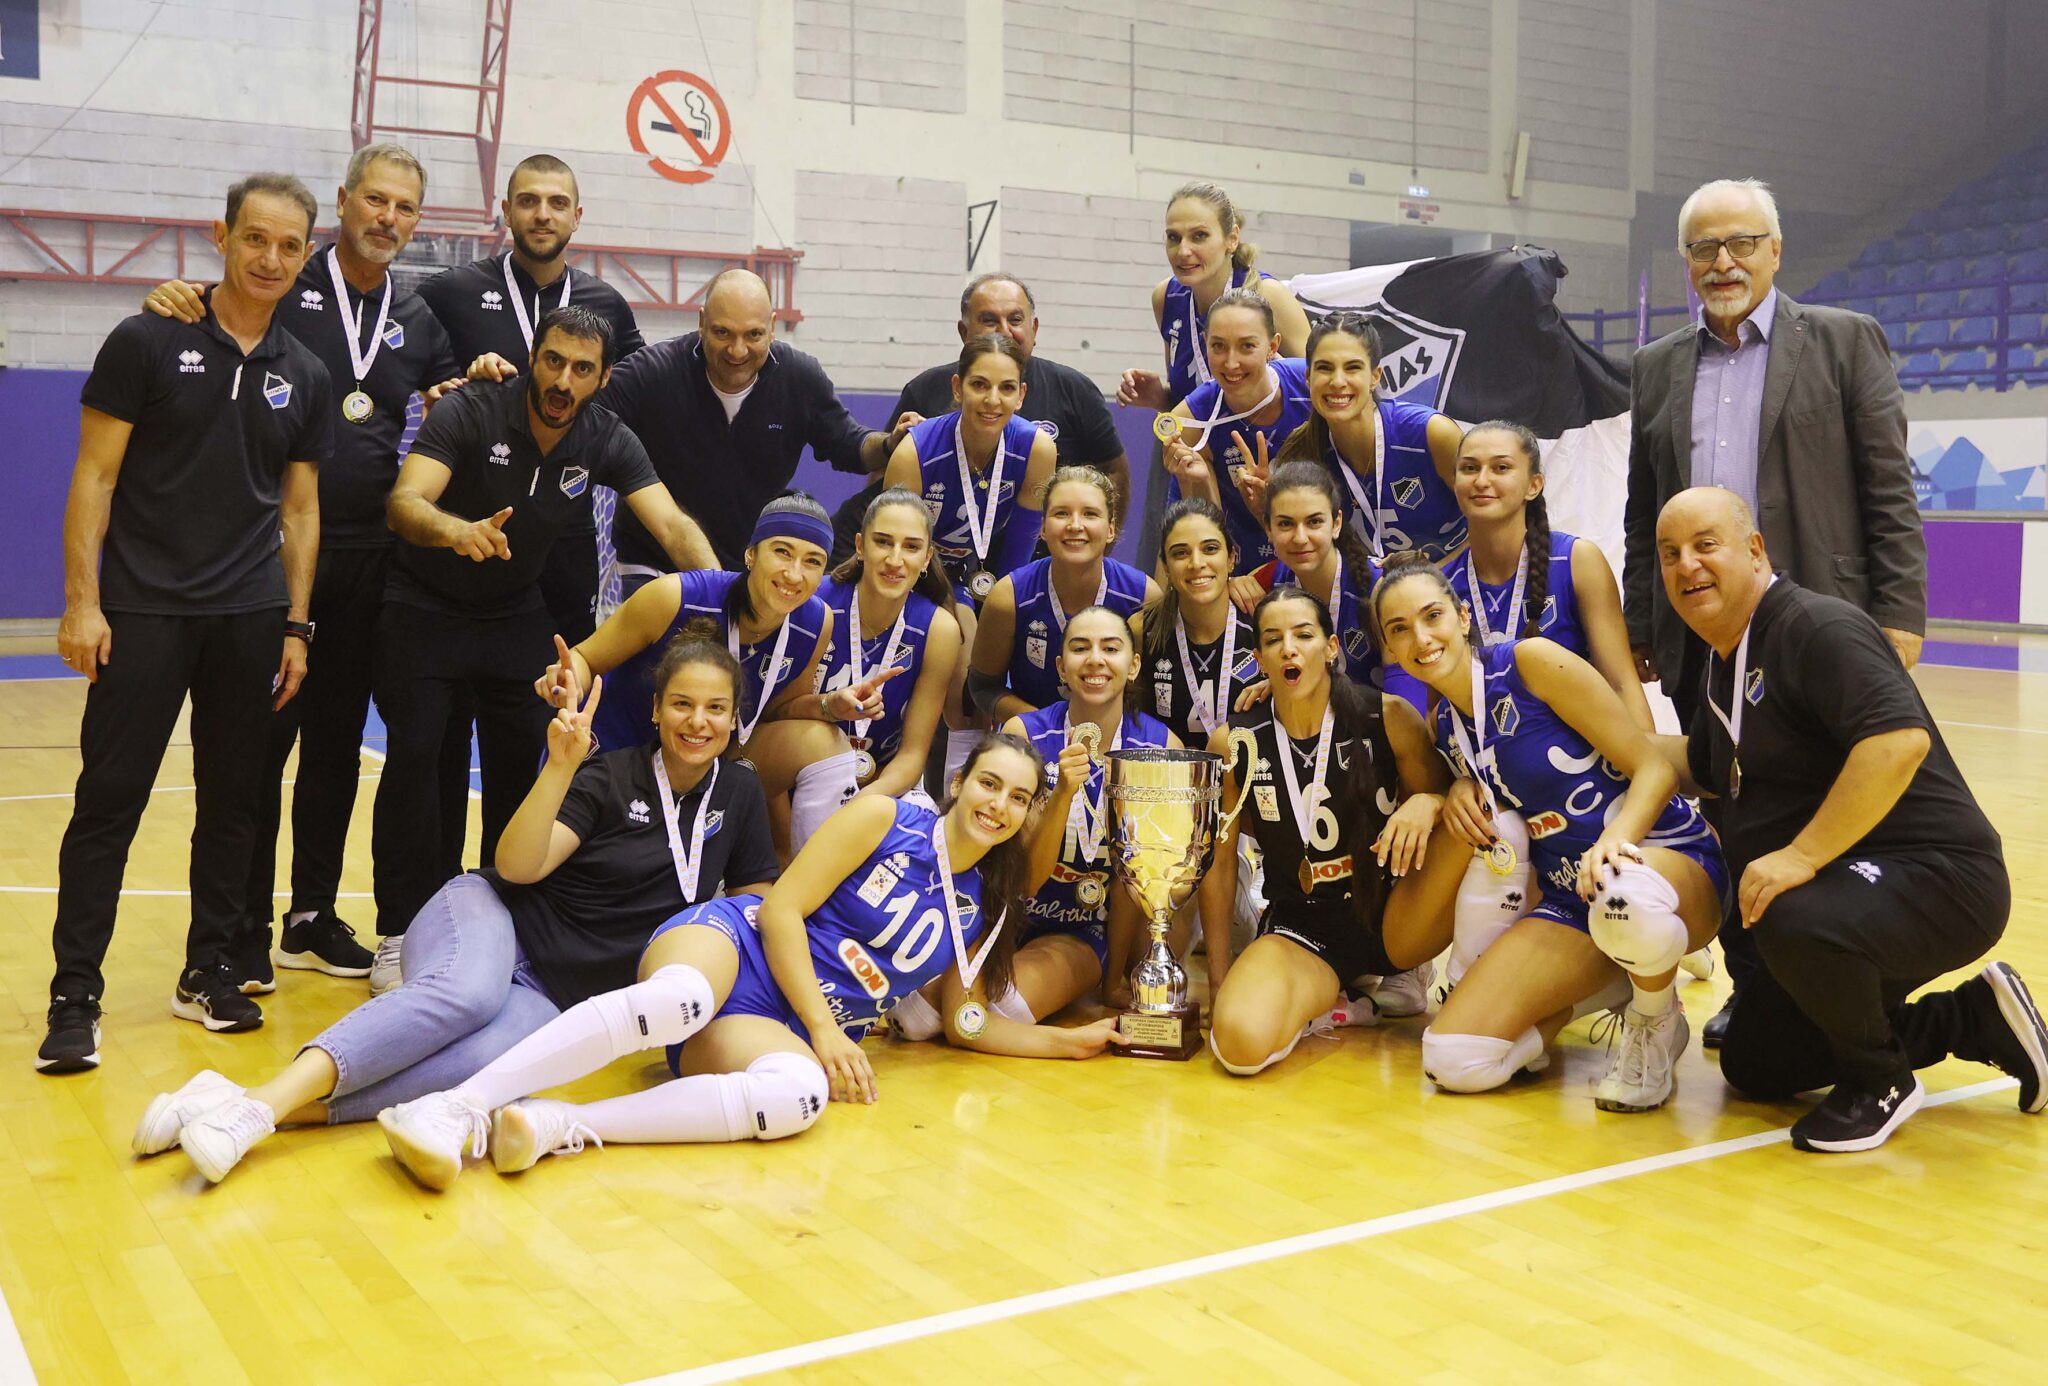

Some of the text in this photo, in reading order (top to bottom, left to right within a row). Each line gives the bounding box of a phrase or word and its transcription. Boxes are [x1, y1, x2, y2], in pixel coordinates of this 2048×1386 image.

[301, 301, 323, 311] errea
[481, 302, 502, 311] errea
[179, 364, 205, 373] errea
[489, 455, 509, 466] errea
[941, 503, 980, 544] 2
[1153, 671, 1172, 680] errea
[1187, 679, 1216, 733] 4
[628, 812, 650, 824] errea
[1301, 782, 1340, 852] 6
[1528, 813, 1562, 836] ON
[884, 857, 906, 879] errea
[1848, 864, 1877, 884] errea
[1500, 902, 1520, 912] errea
[1604, 911, 1629, 921] errea
[866, 889, 945, 974] 10
[844, 944, 885, 992] ION
[680, 1002, 690, 1026] errea
[798, 1097, 809, 1120] errea
